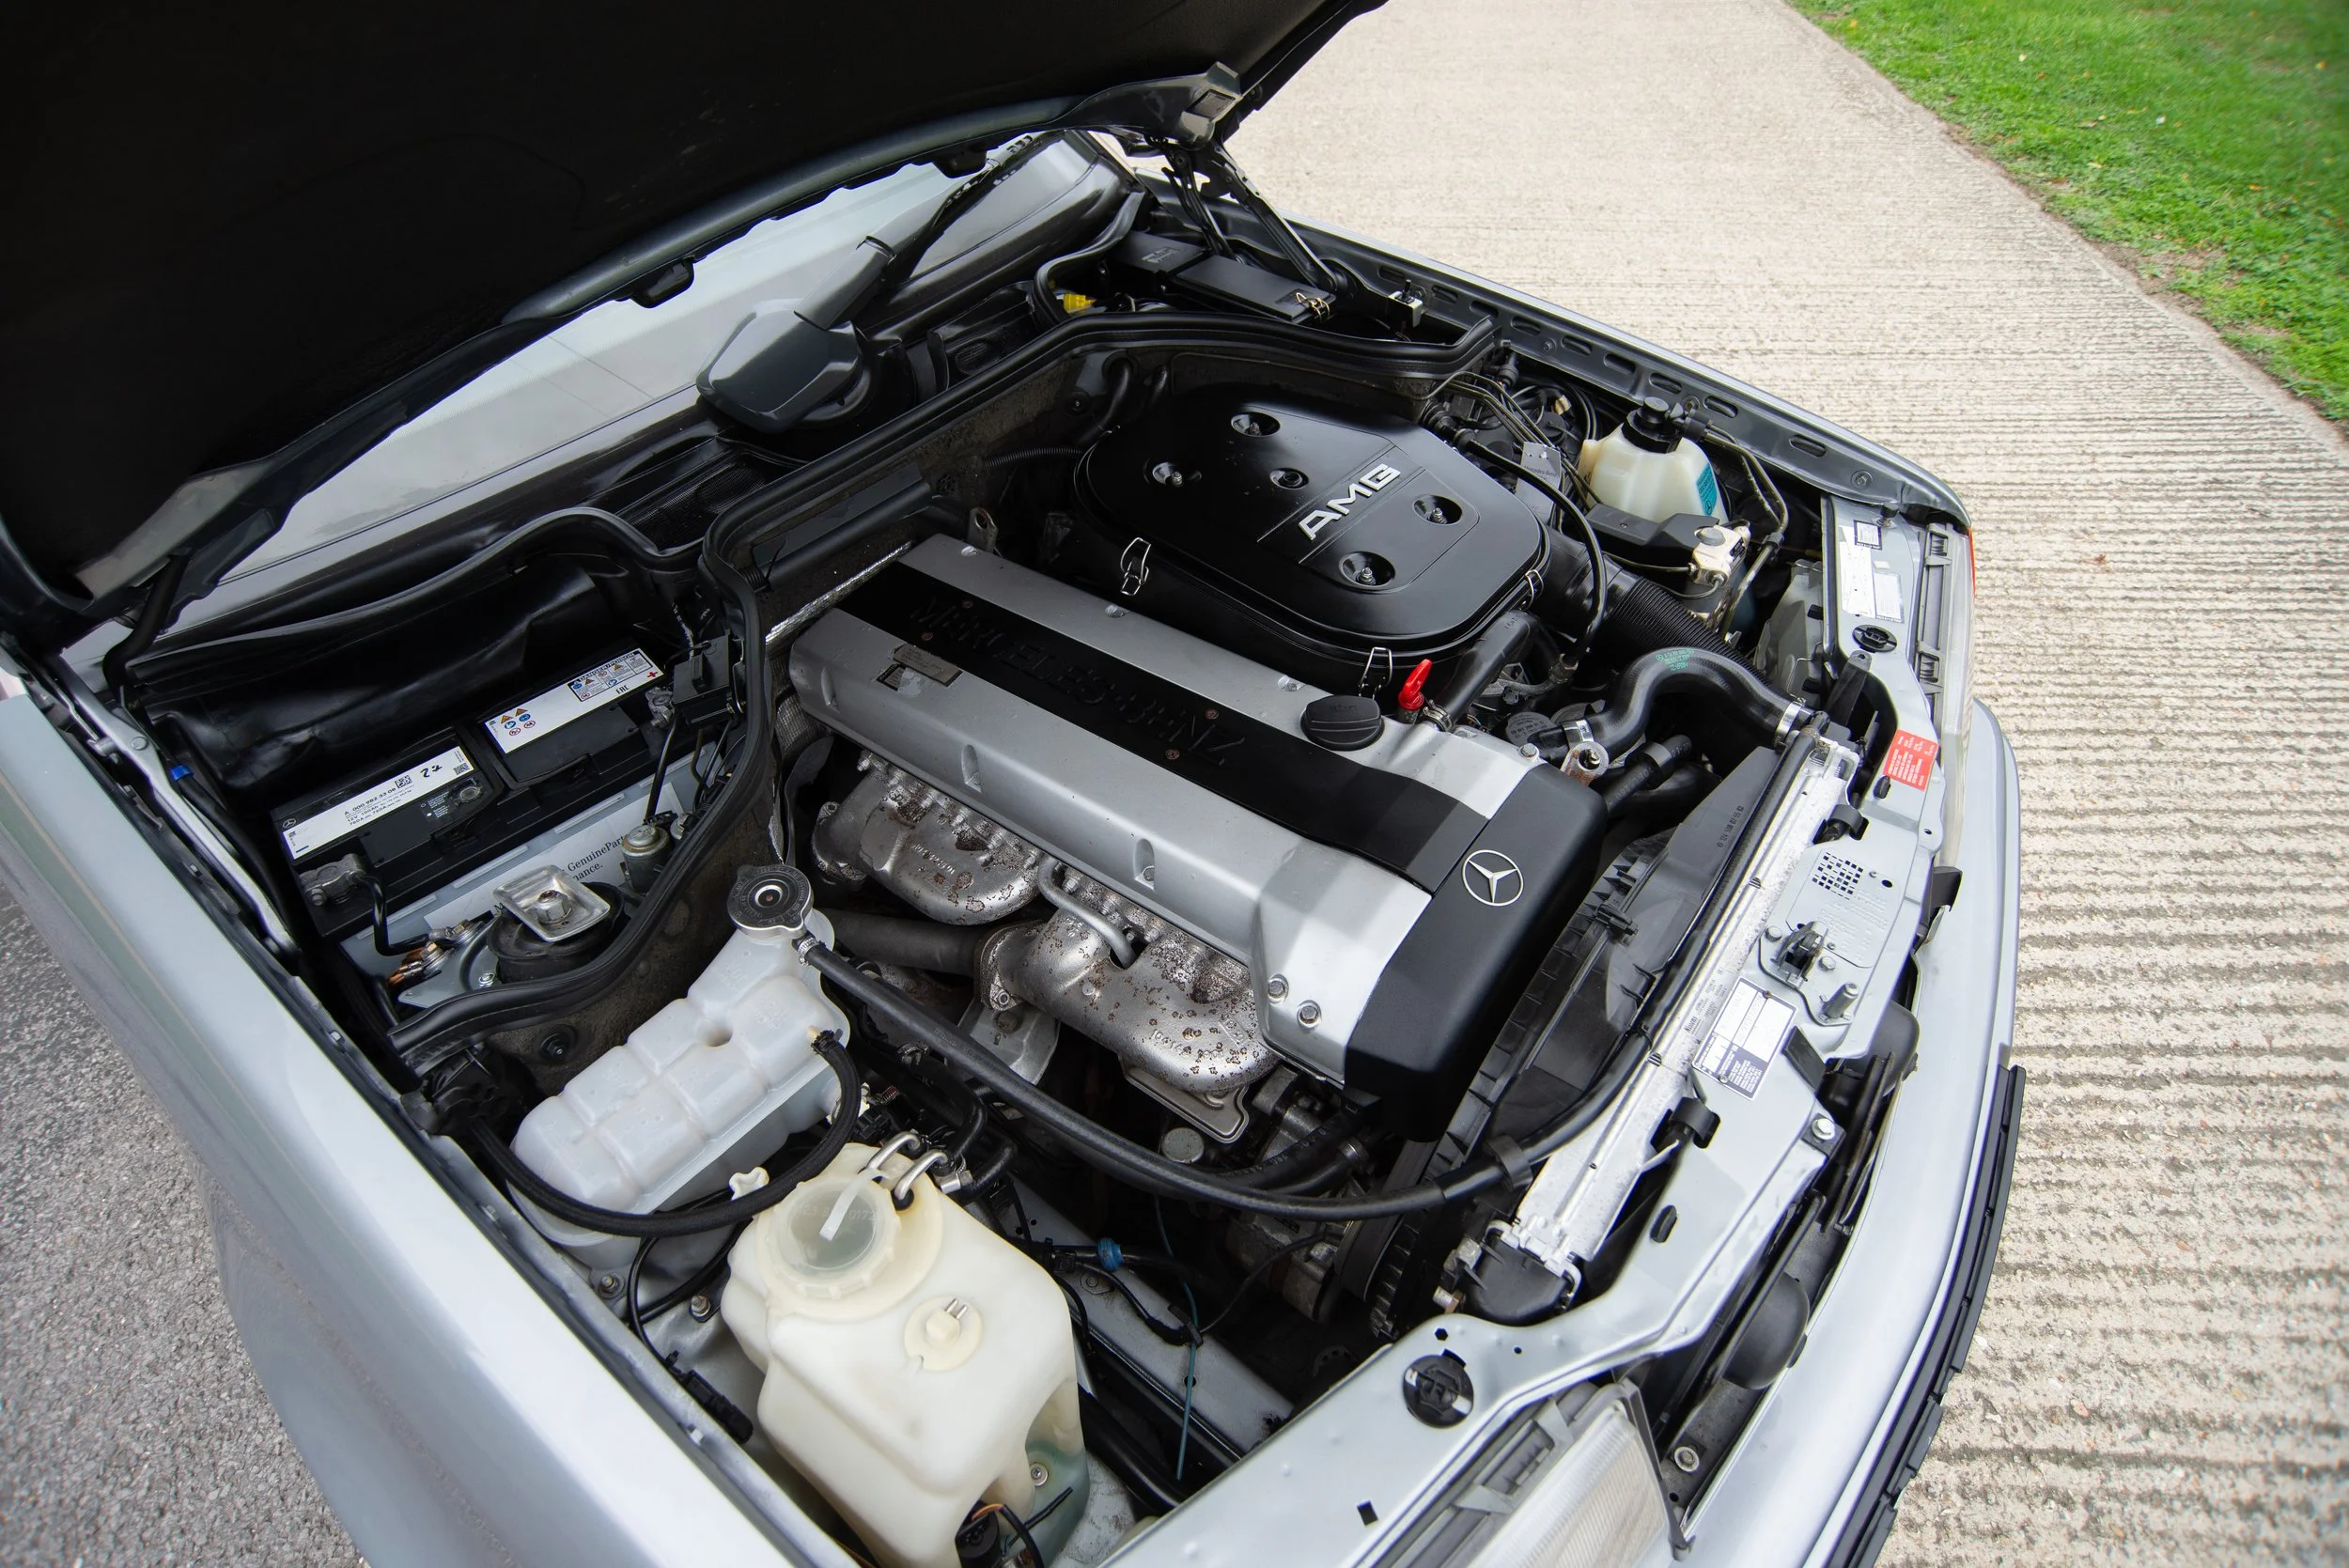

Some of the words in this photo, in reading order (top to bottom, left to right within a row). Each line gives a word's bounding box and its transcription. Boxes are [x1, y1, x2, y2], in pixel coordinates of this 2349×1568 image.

[1298, 463, 1401, 541] AMG
[615, 685, 629, 694] EAC
[568, 836, 624, 872] GenuinePart
